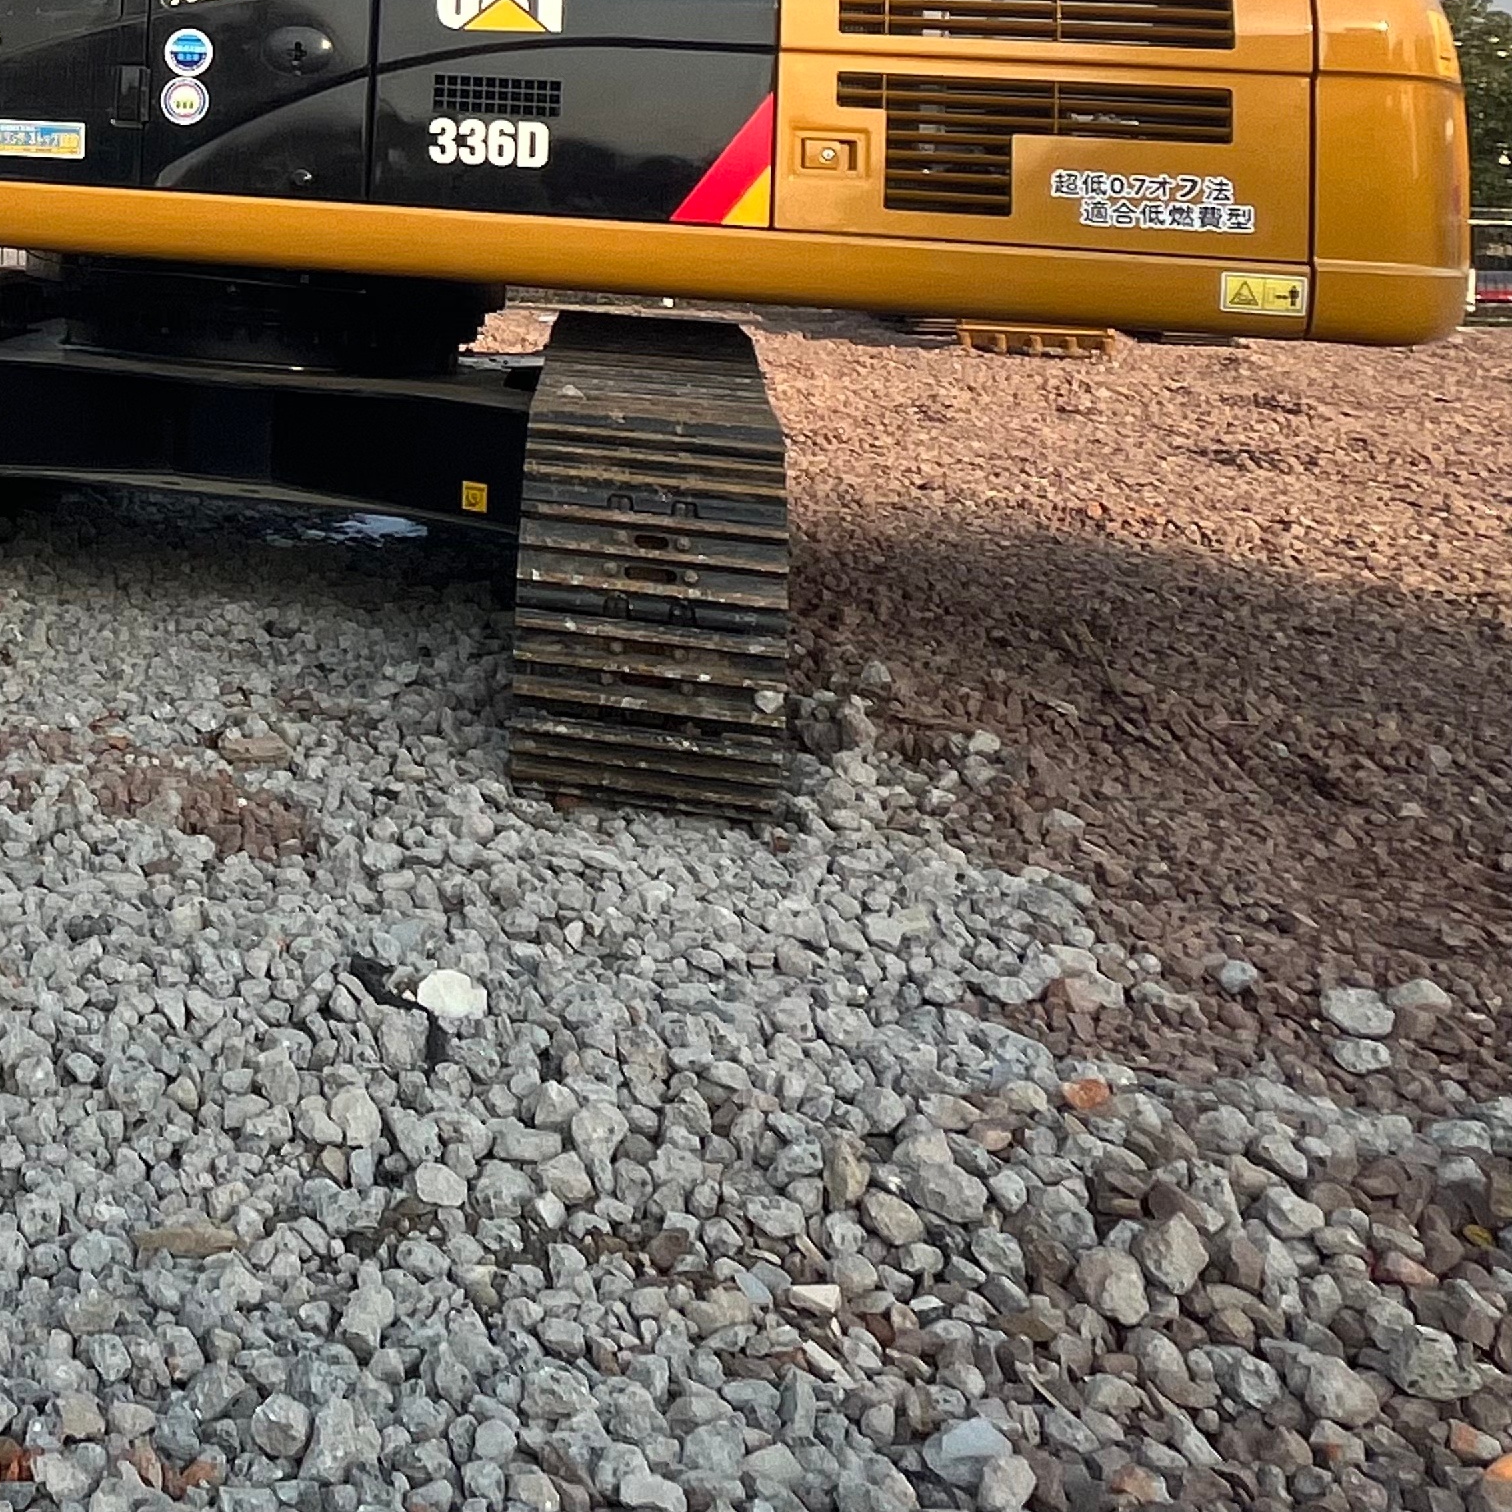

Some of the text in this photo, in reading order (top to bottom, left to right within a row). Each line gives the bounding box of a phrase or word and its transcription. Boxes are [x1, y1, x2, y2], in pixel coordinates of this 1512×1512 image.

[428, 117, 551, 168] 336D
[1081, 199, 1254, 232] 適合低燃費型
